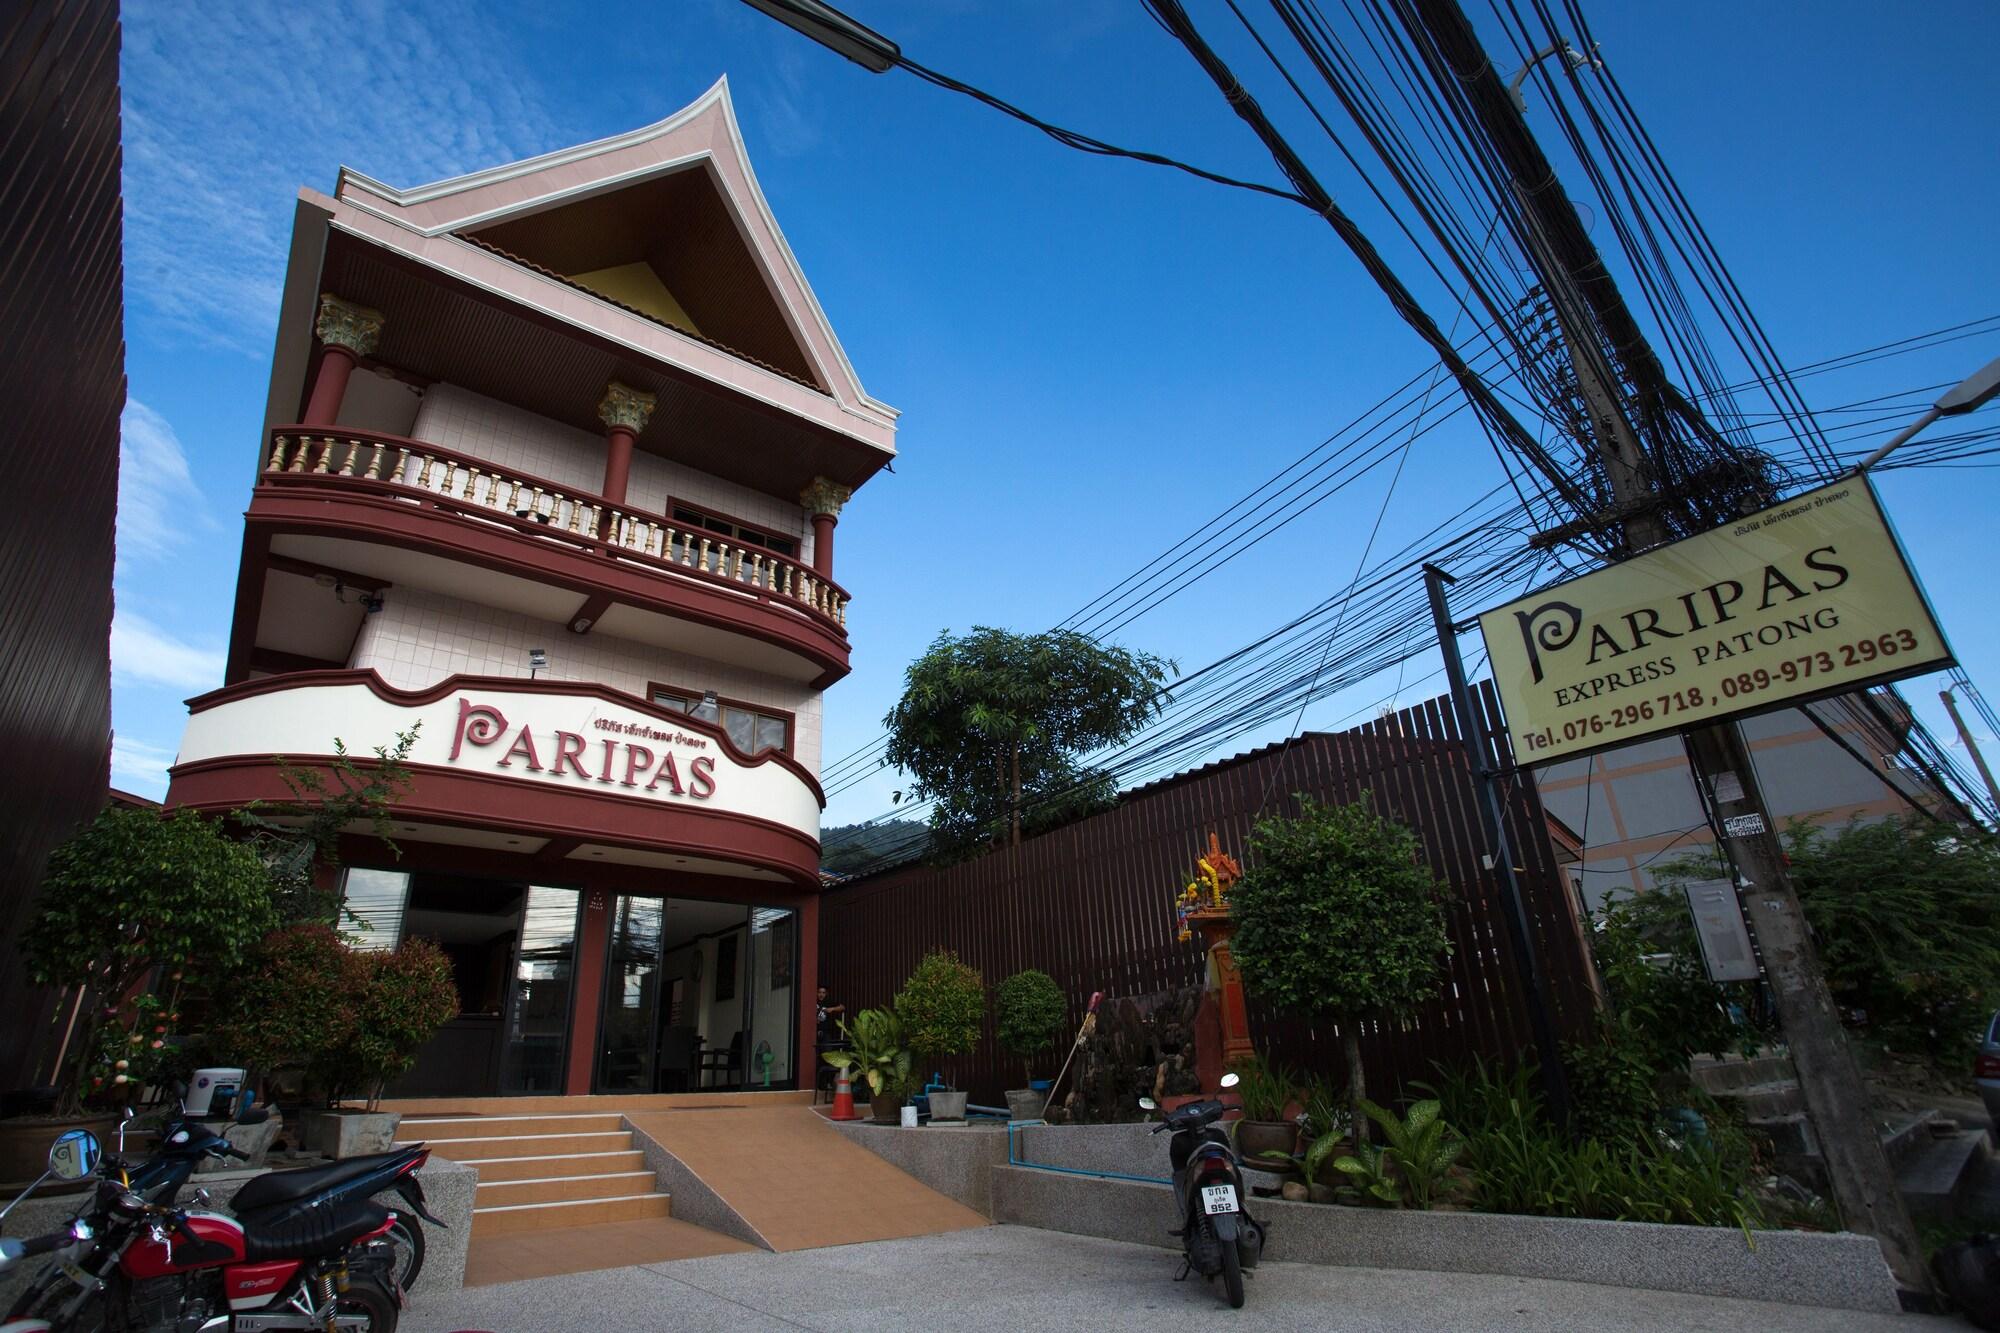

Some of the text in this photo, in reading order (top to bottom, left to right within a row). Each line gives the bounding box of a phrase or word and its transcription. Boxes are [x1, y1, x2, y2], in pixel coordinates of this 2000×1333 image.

[1513, 545, 1850, 685] PARIPAS
[1554, 607, 1840, 707] EXPRESS PATONG
[1523, 728, 1562, 751] Tel.
[1563, 700, 1654, 741] 076-296
[1721, 651, 1835, 698] 089-973
[1839, 629, 1918, 667] 2963
[448, 697, 717, 800] PARIPAS
[1211, 1202, 1232, 1212] 952
